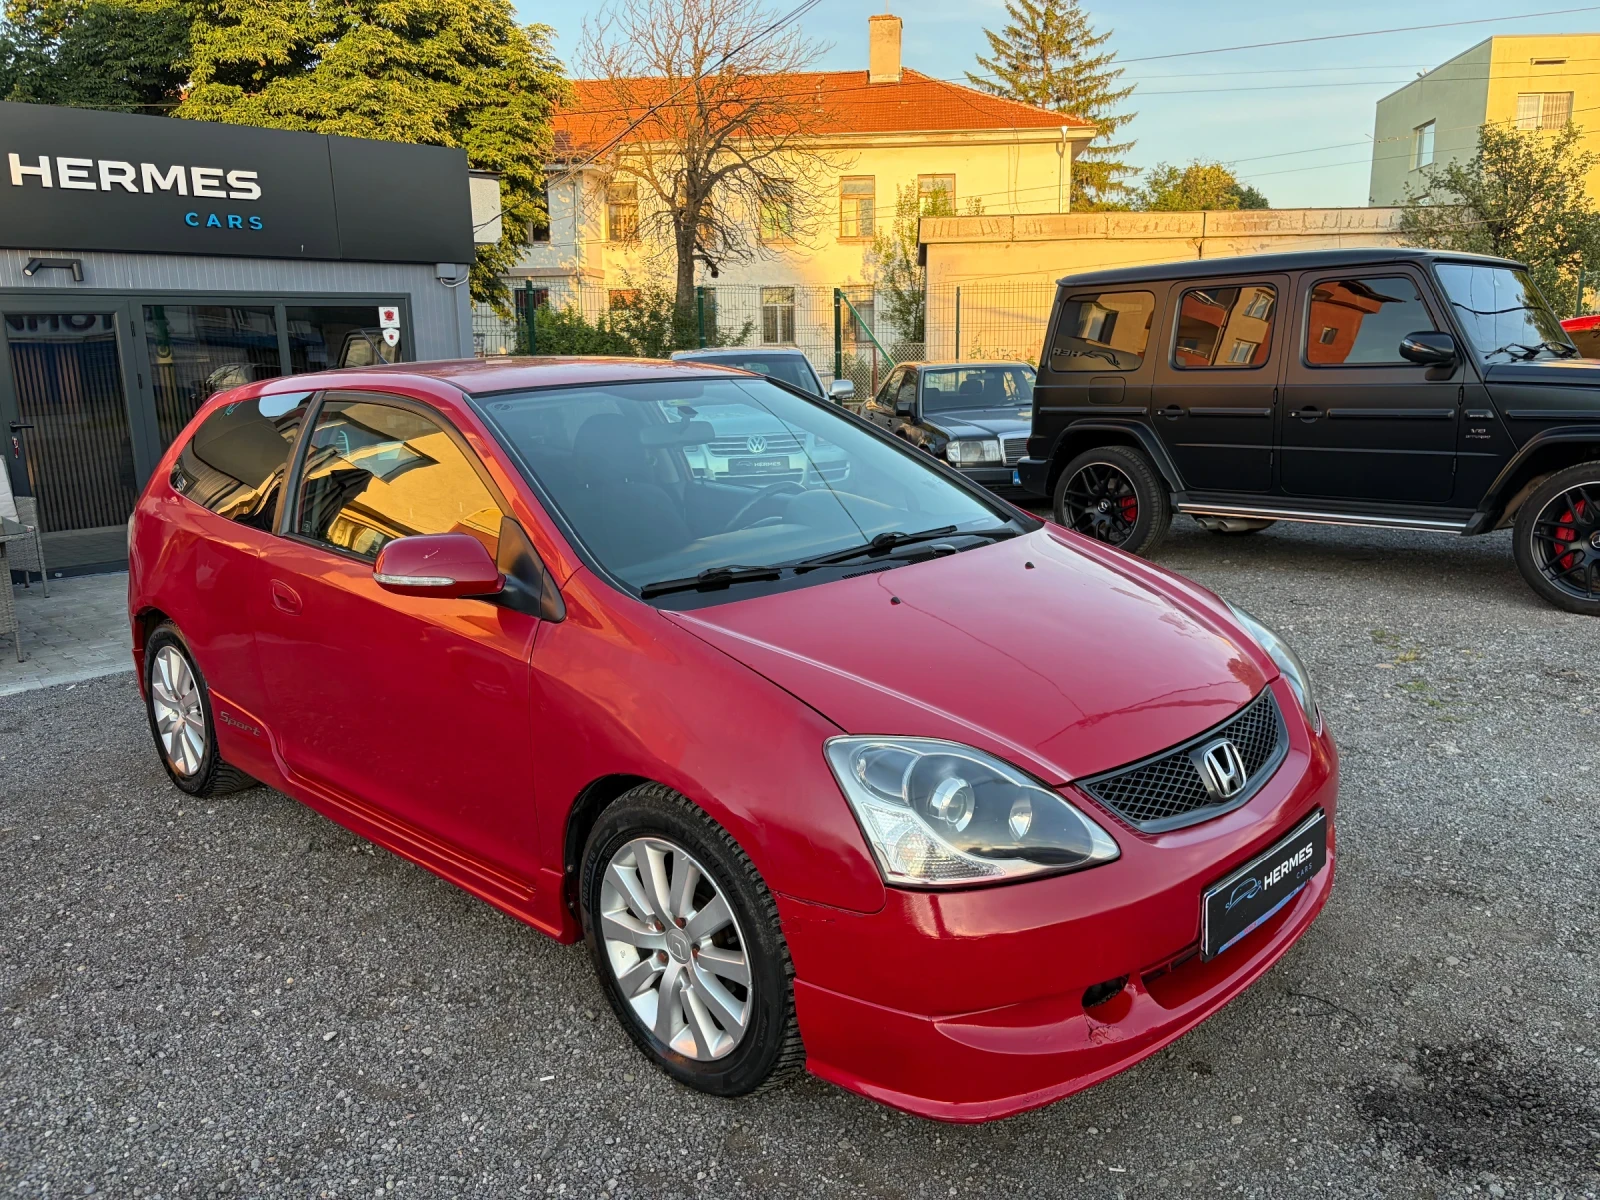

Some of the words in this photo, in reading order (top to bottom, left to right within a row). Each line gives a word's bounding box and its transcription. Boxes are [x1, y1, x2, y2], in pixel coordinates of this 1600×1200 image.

[8, 152, 262, 201] HERMES
[185, 212, 264, 231] CARS
[219, 711, 261, 737] Sport
[1264, 842, 1313, 890] HERMES
[1296, 862, 1313, 879] CARS
[582, 867, 590, 906] 205/55
